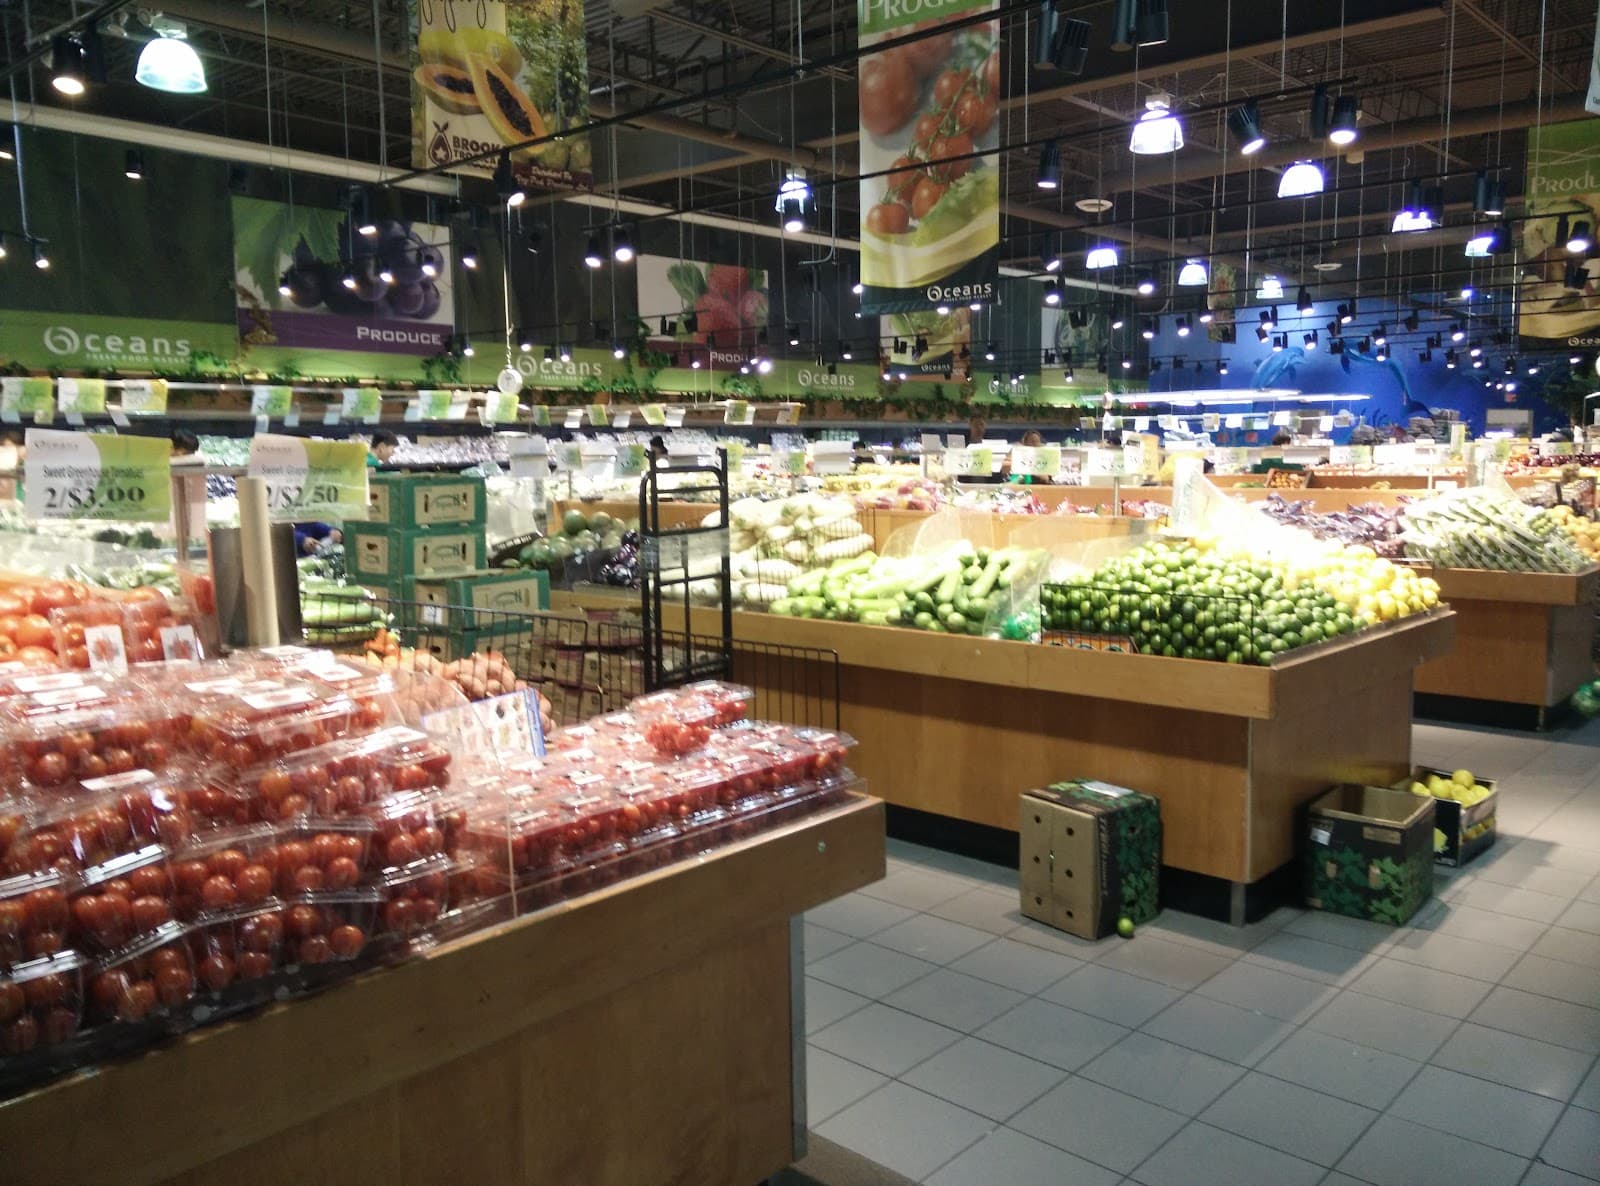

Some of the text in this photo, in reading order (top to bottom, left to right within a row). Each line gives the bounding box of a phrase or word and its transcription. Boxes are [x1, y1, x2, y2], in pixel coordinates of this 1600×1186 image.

[927, 283, 992, 302] Oceans
[43, 326, 191, 356] Oceans
[356, 326, 441, 345] PRODUCE
[516, 355, 602, 377] Oceans
[798, 369, 855, 386] Oceans
